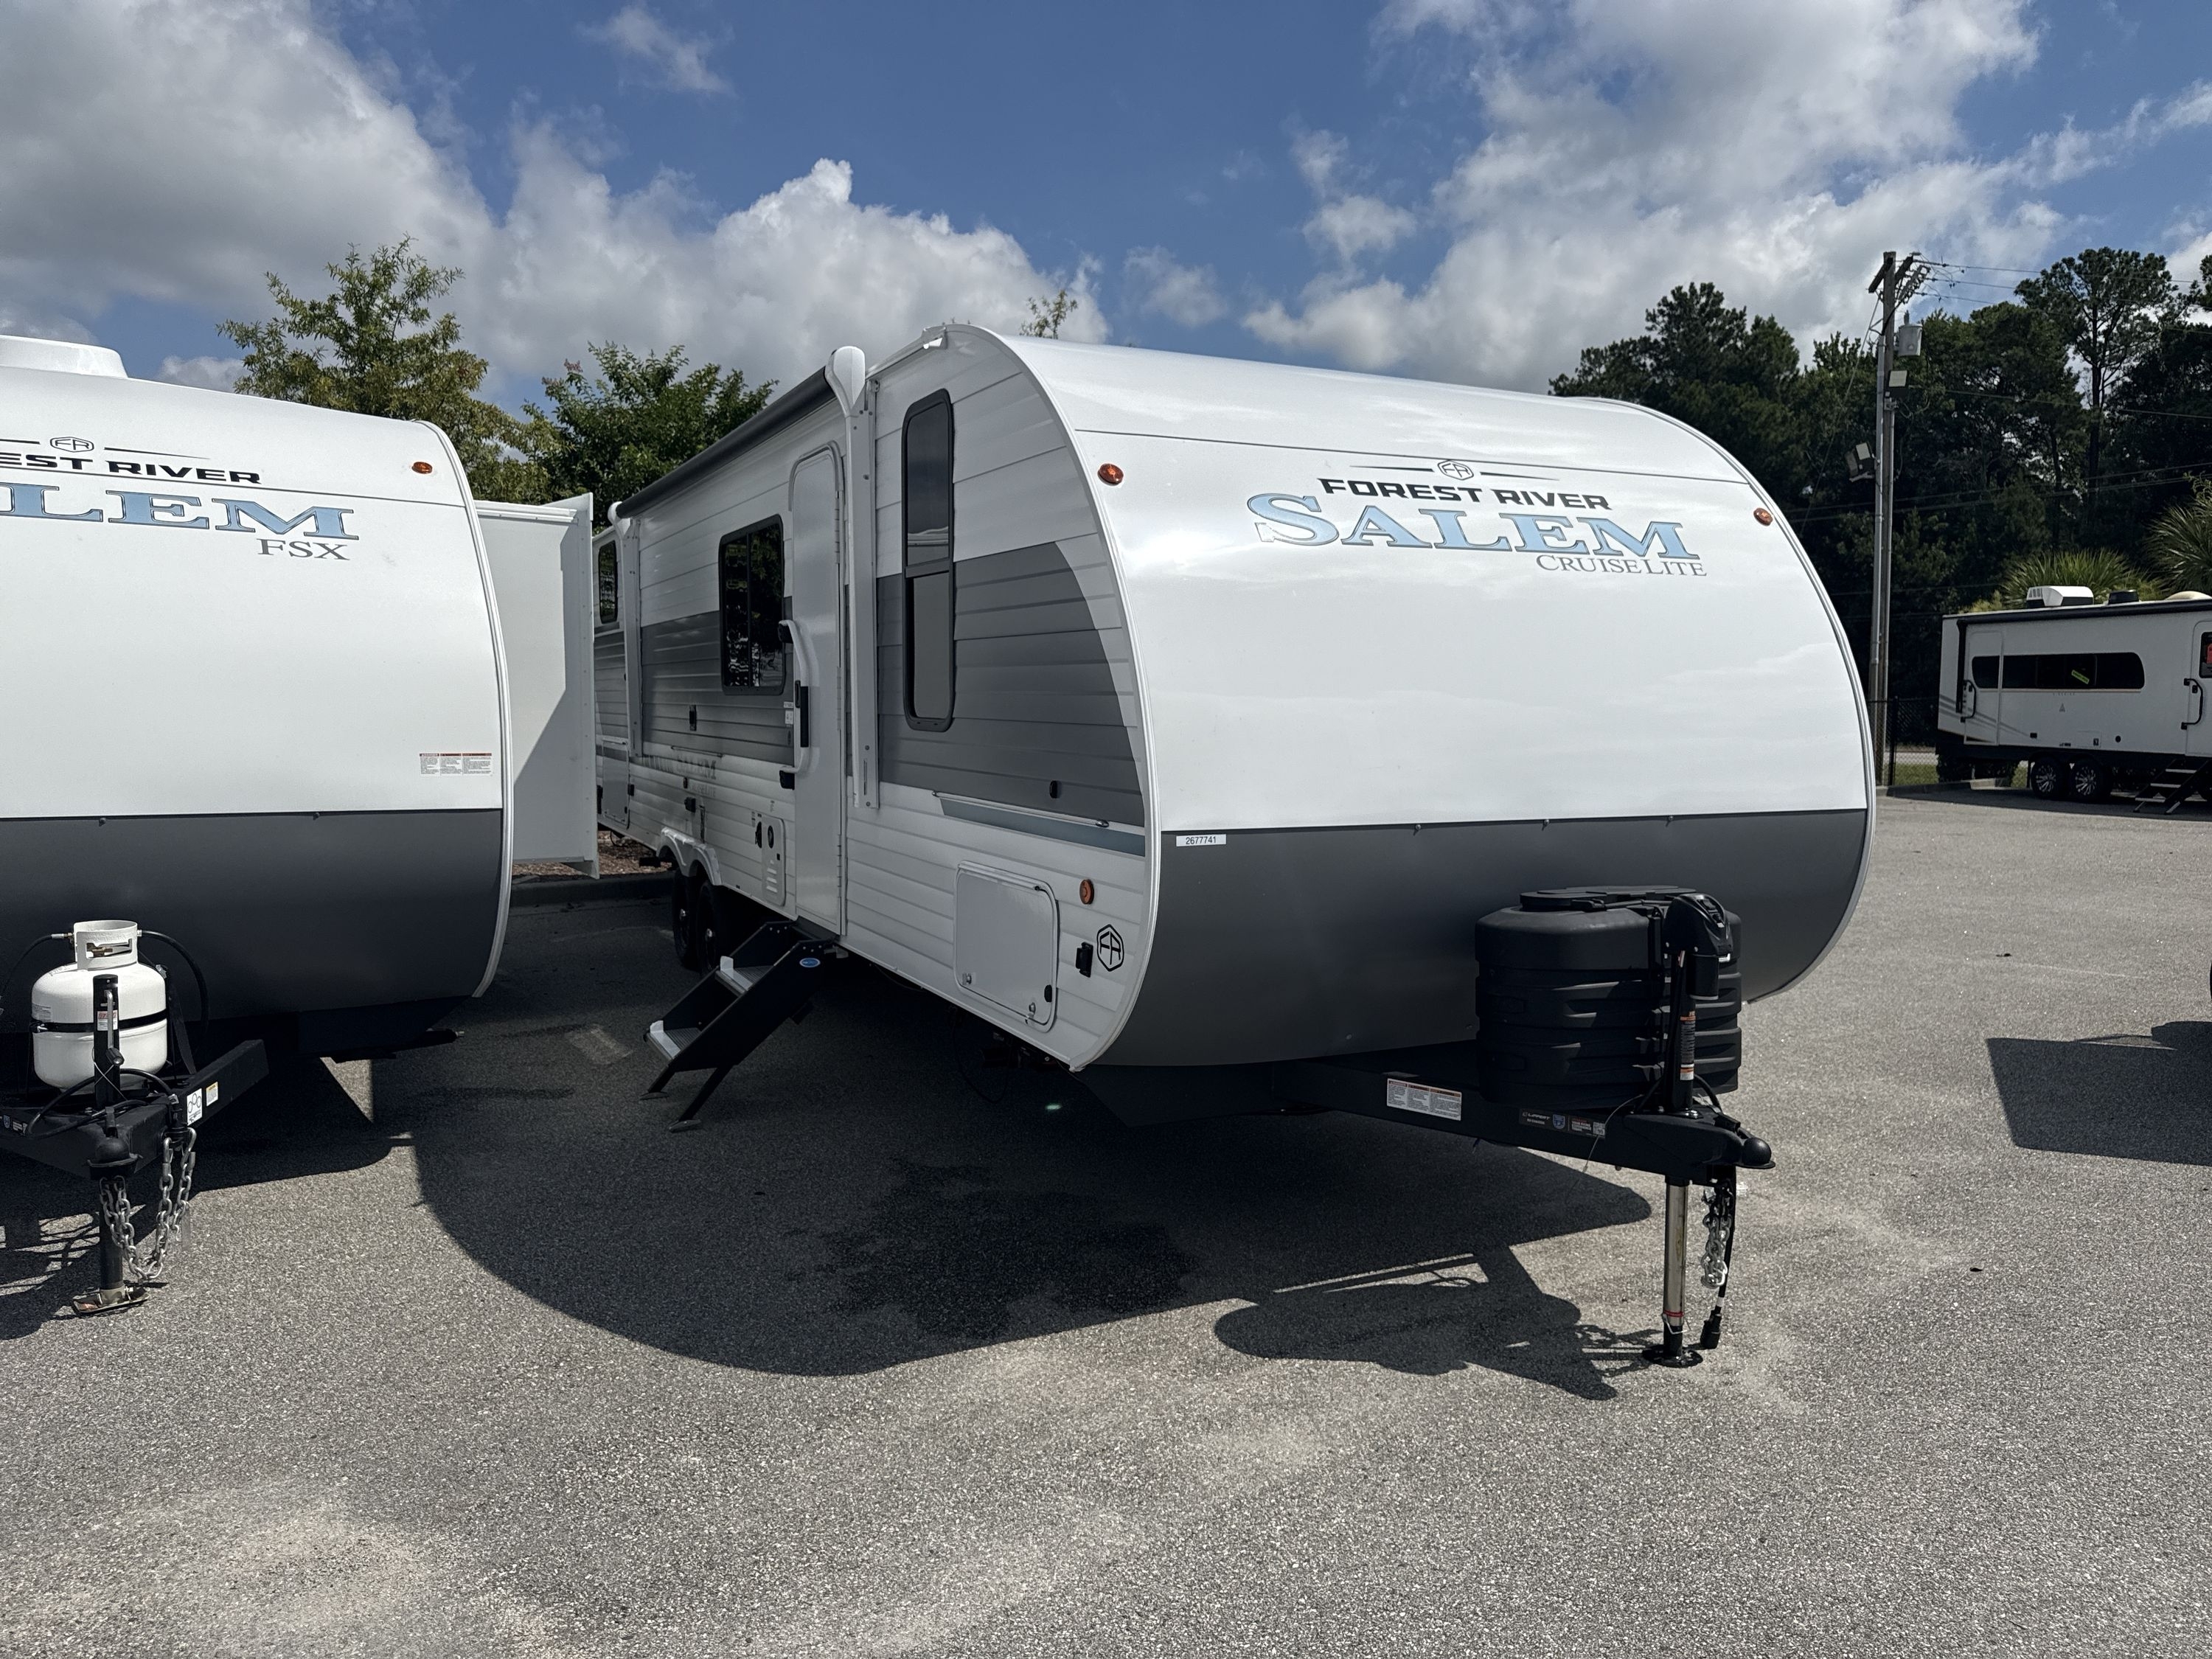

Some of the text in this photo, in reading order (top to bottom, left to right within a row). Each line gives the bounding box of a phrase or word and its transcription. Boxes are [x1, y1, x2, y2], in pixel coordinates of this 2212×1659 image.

[105, 461, 262, 484] RIVER
[1316, 478, 1613, 510] FOREST RIVER
[1247, 493, 1700, 560] SALEM
[256, 538, 350, 561] FSX
[1185, 835, 1217, 845] 2677741
